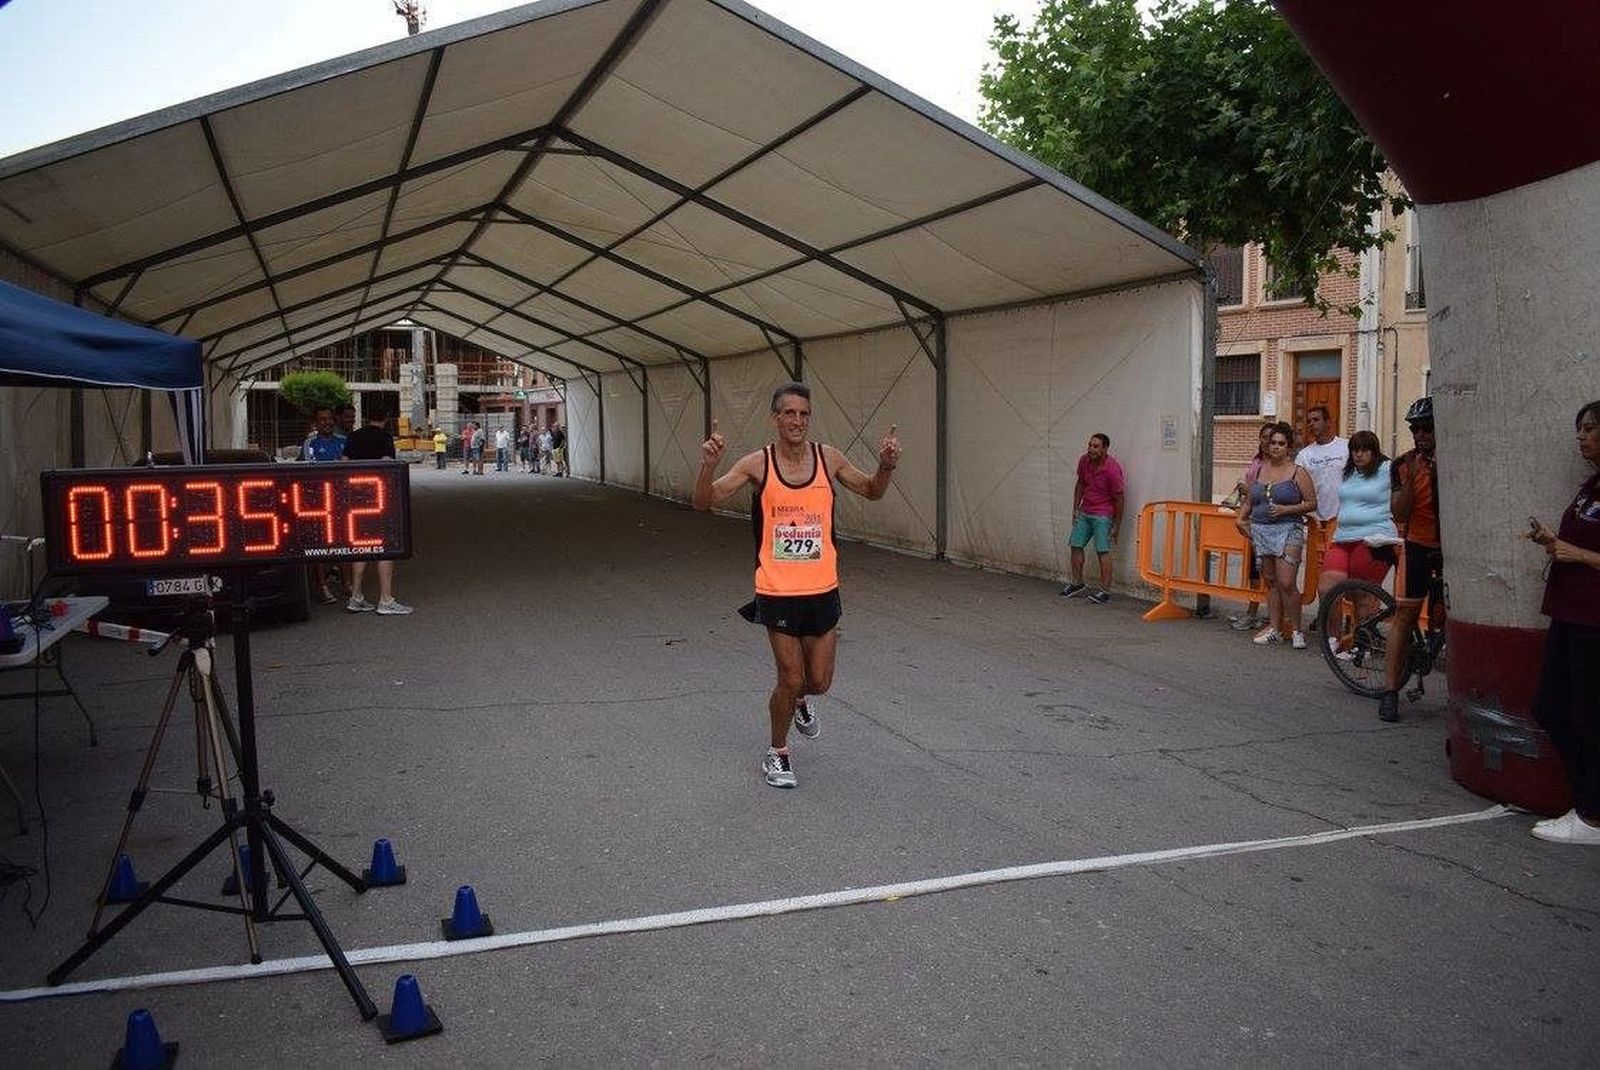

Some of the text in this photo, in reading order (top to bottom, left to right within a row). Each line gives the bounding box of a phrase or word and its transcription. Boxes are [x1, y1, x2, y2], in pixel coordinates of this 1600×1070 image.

[68, 476, 386, 560] 00:35:42
[783, 539, 814, 553] 279
[156, 579, 218, 593] 0784 GK
